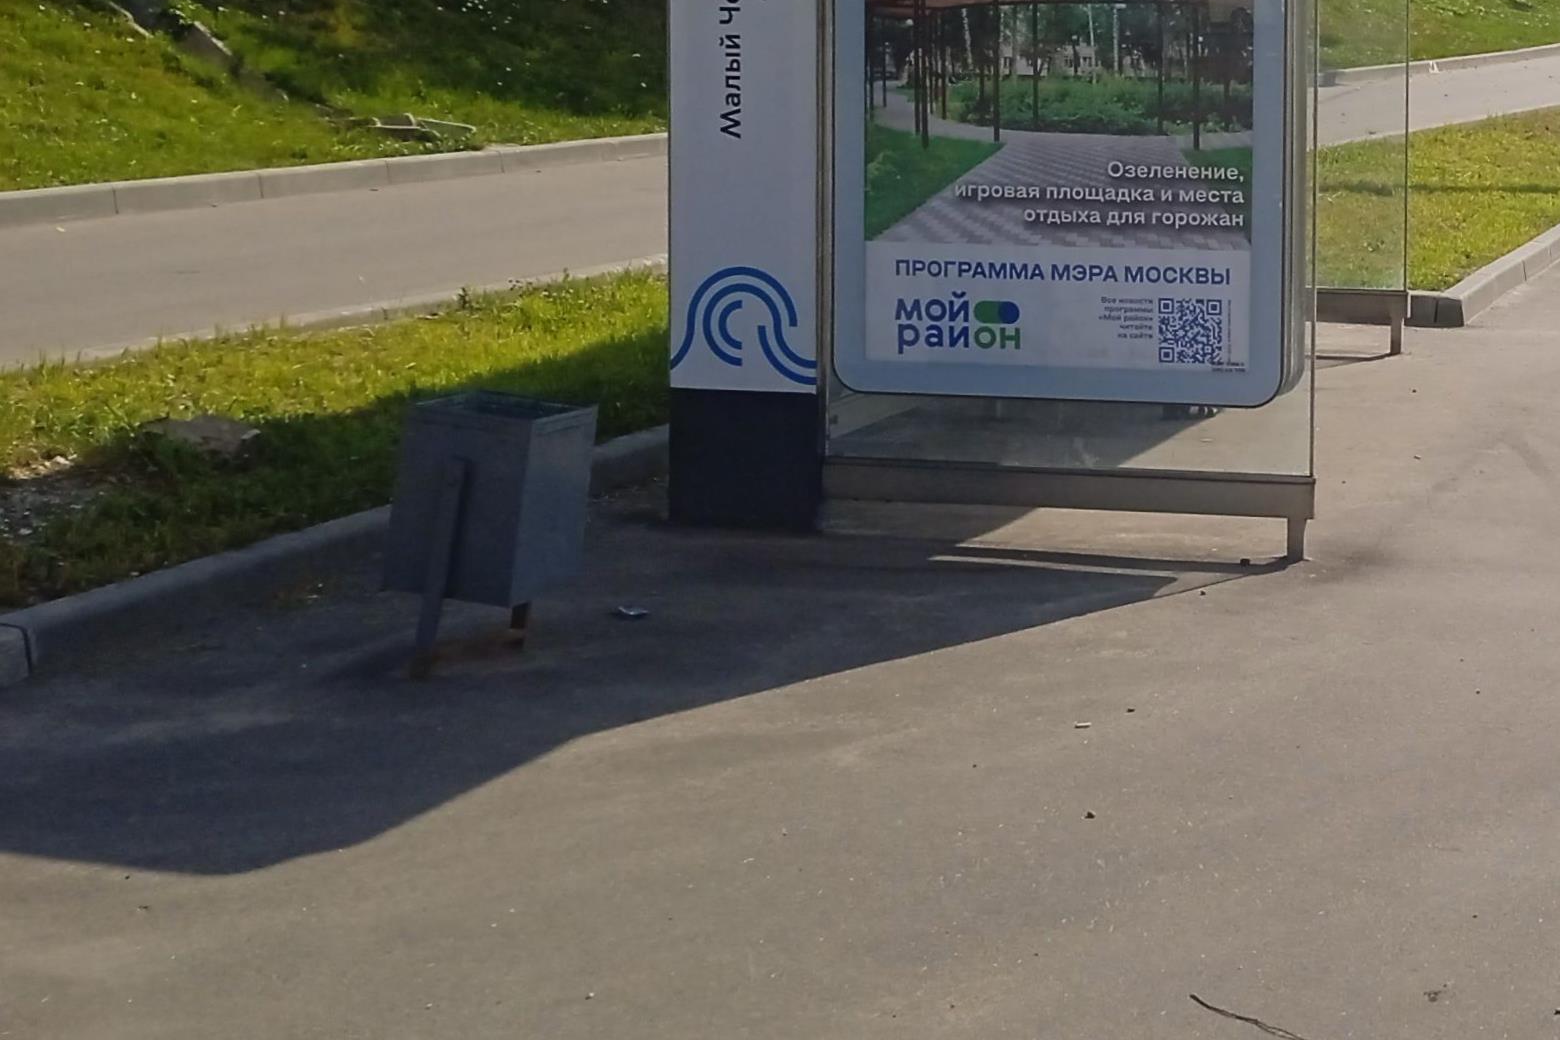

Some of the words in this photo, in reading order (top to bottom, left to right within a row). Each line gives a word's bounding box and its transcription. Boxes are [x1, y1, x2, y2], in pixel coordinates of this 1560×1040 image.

[718, 32, 743, 139] Малый
[1107, 161, 1245, 184] Озеленение,
[955, 185, 1040, 200] игровая
[1046, 187, 1155, 206] площадка
[1161, 190, 1173, 201] и
[1179, 191, 1245, 204] места
[1024, 208, 1101, 226] отдыха
[1107, 211, 1146, 226] для
[1151, 212, 1245, 229] горожан
[895, 259, 1045, 282] ПРОГРАММА
[1051, 264, 1119, 284] МЭРА
[1124, 266, 1231, 286] МОСКВЫ
